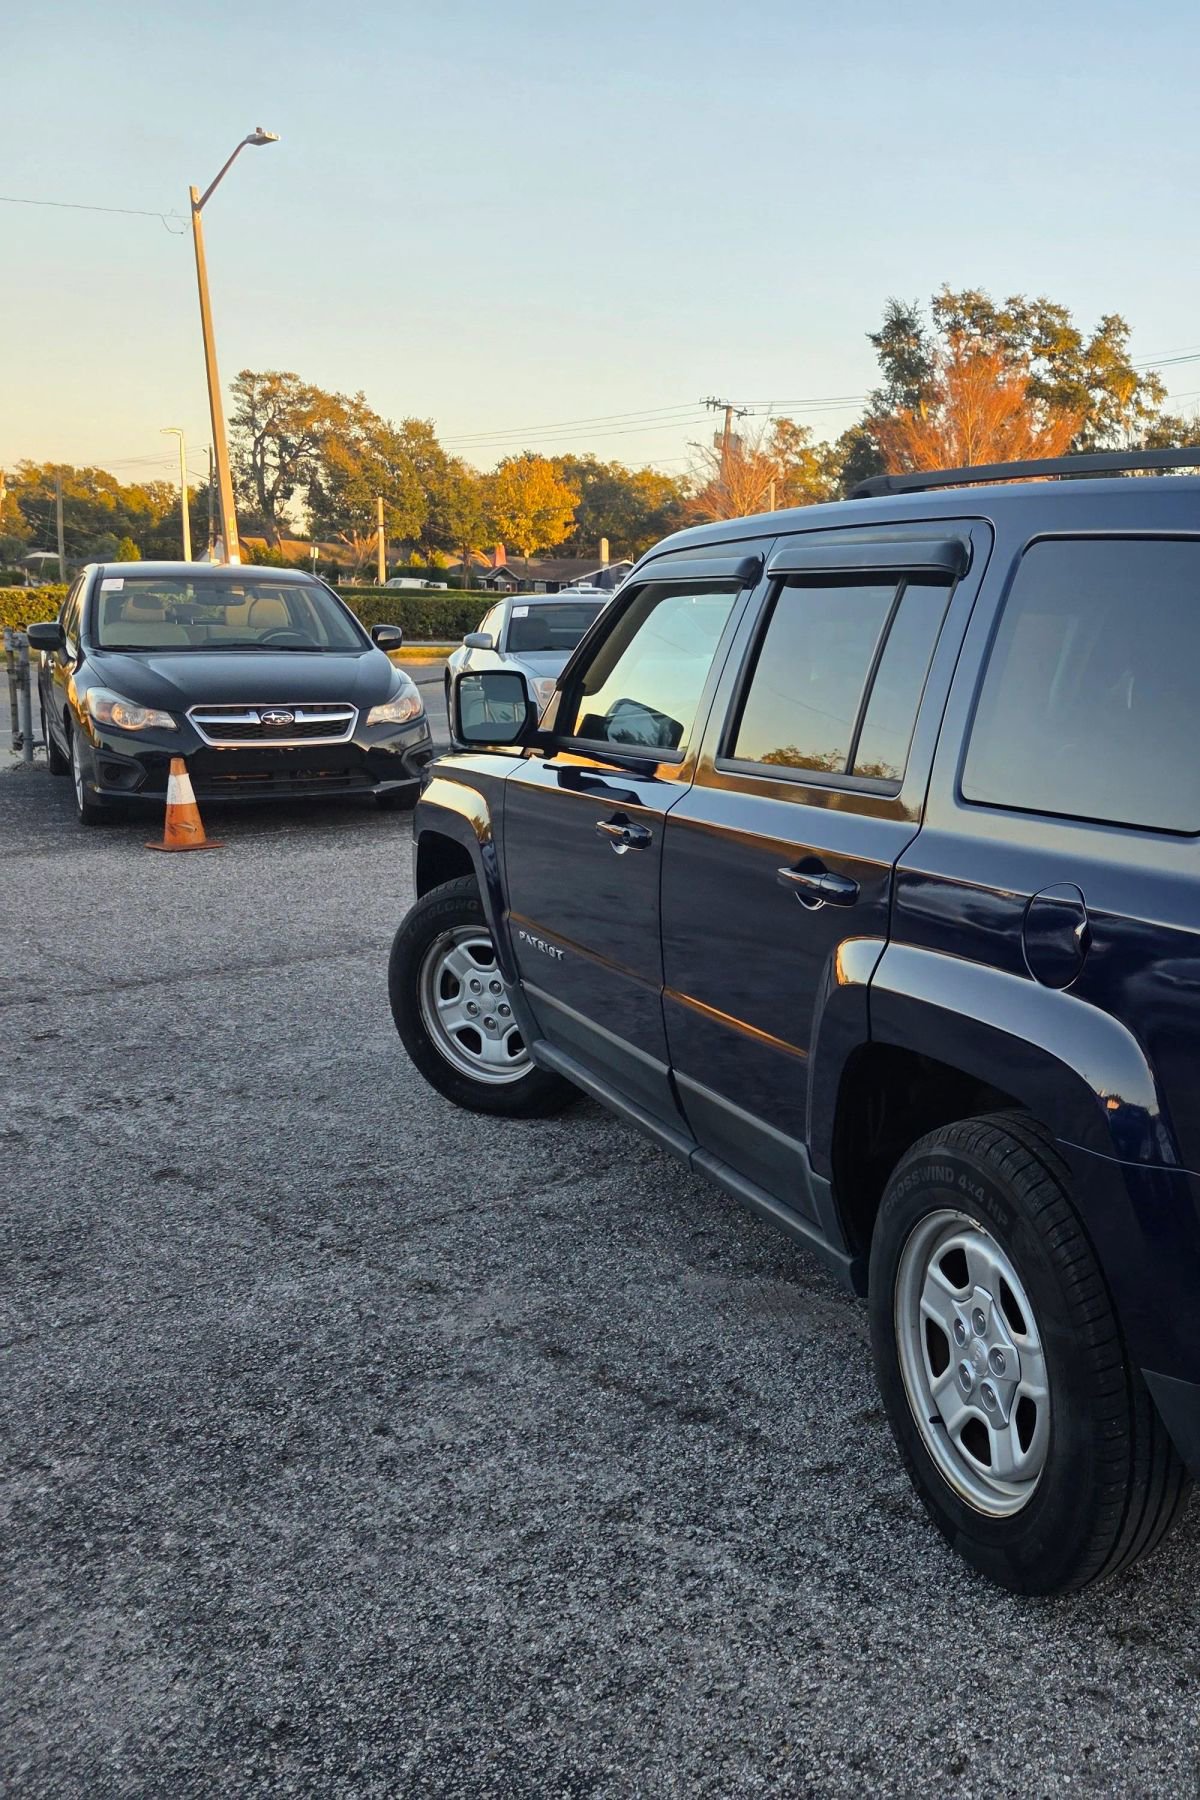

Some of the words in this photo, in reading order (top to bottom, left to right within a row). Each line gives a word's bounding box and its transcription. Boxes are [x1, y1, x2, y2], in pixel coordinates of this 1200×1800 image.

[519, 930, 565, 961] PATRIOT
[885, 1165, 954, 1214] CROSSWIND
[987, 1197, 1009, 1226] HP
